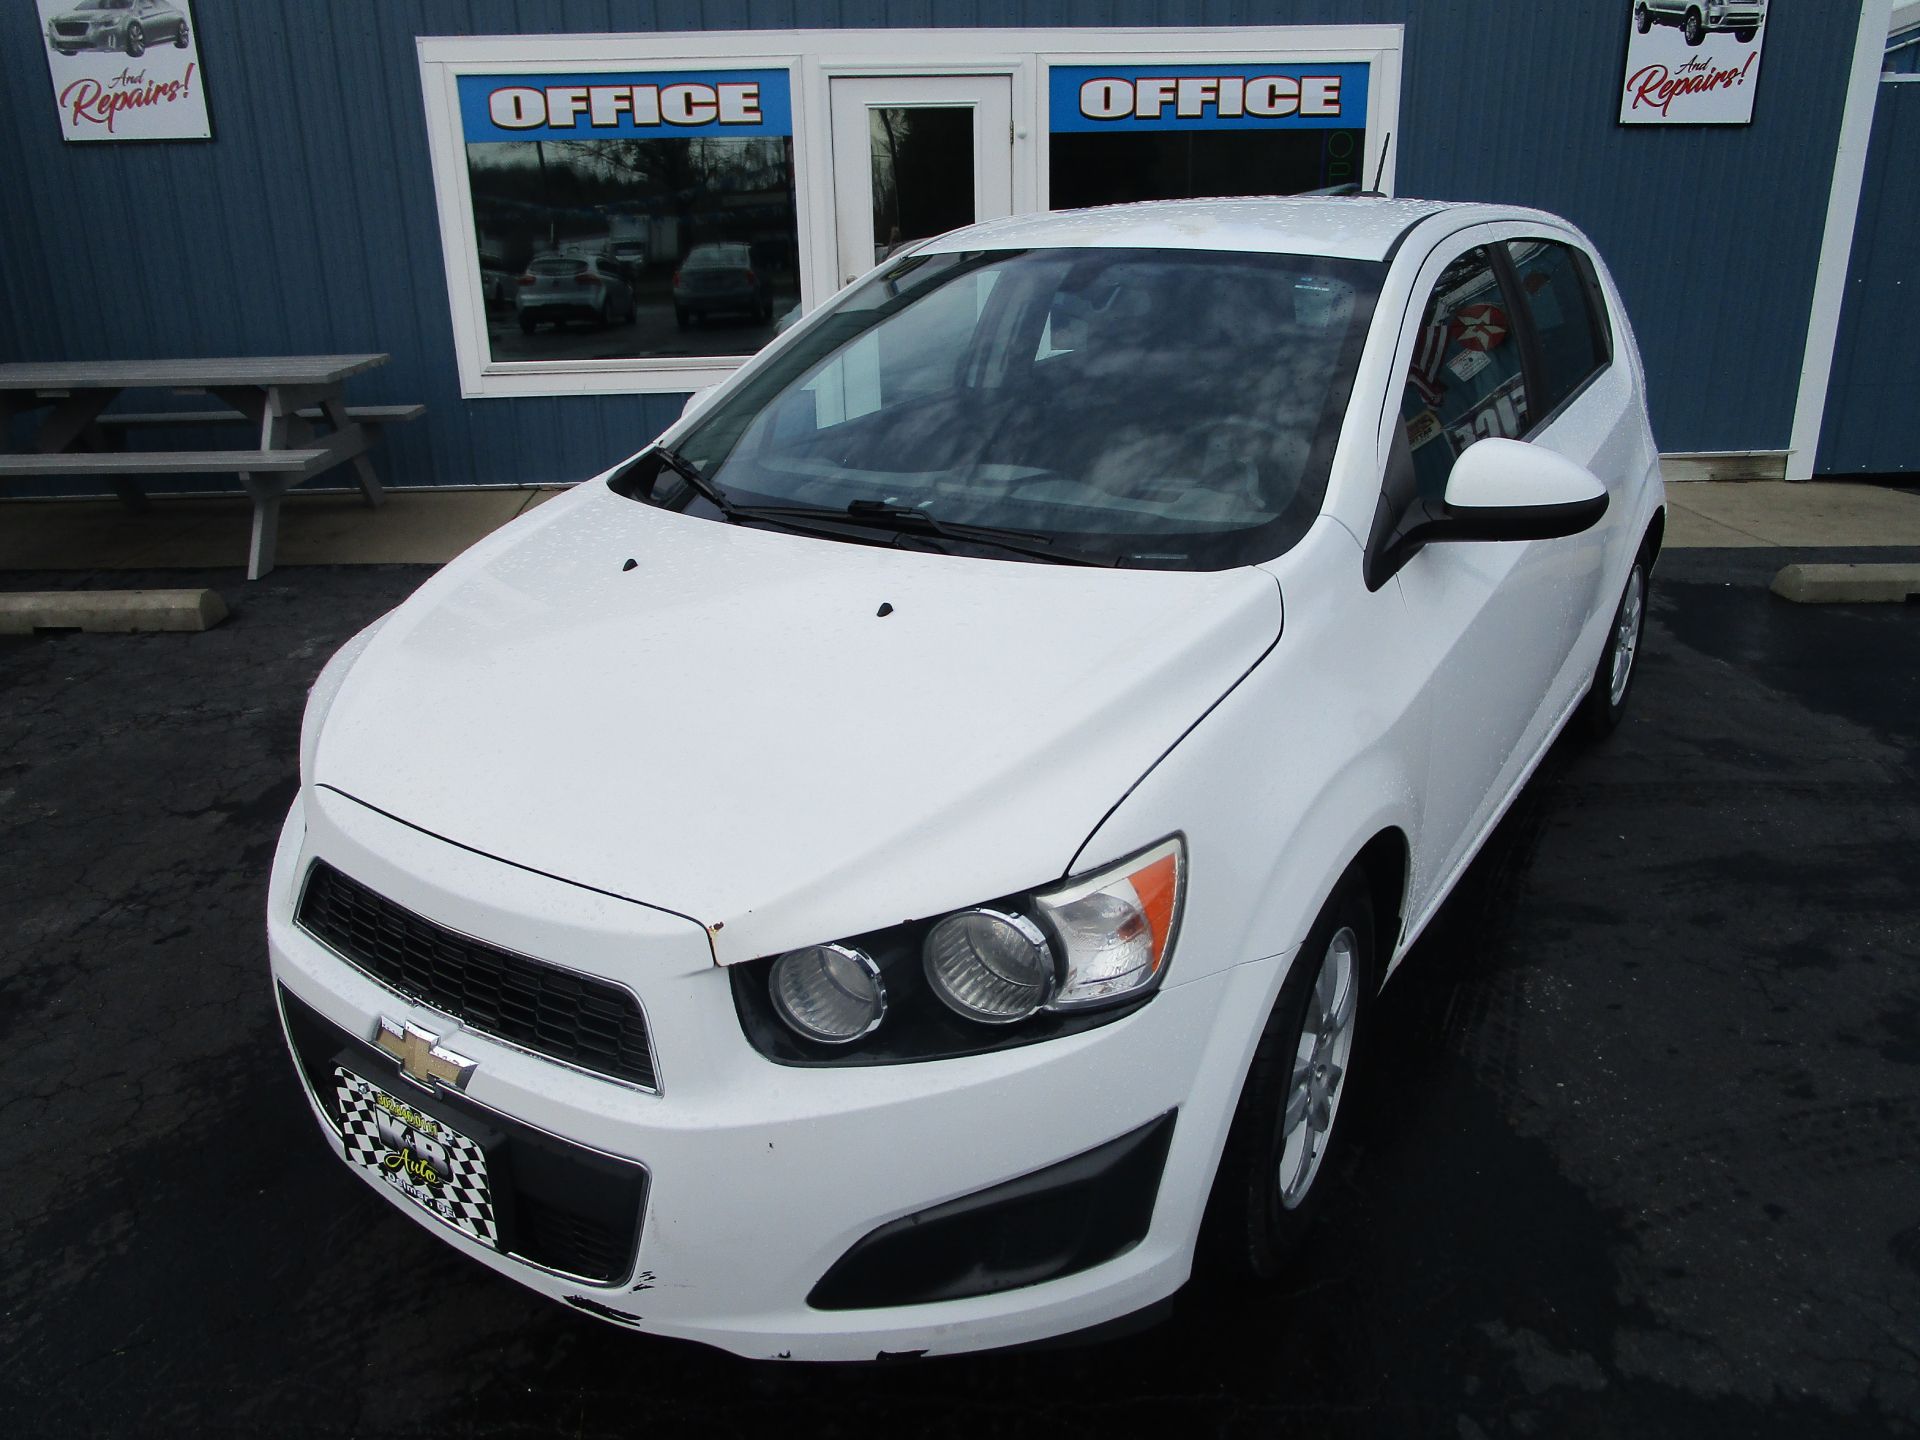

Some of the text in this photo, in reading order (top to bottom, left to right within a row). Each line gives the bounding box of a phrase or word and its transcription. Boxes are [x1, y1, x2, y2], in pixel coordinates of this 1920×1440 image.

[108, 67, 146, 89] And
[1626, 51, 1758, 117] Repairs!
[1674, 55, 1712, 76] And
[60, 63, 195, 133] Repairs!
[489, 82, 763, 130] OFFICE
[1079, 75, 1342, 121] OFFICE
[384, 1148, 439, 1184] Auto
